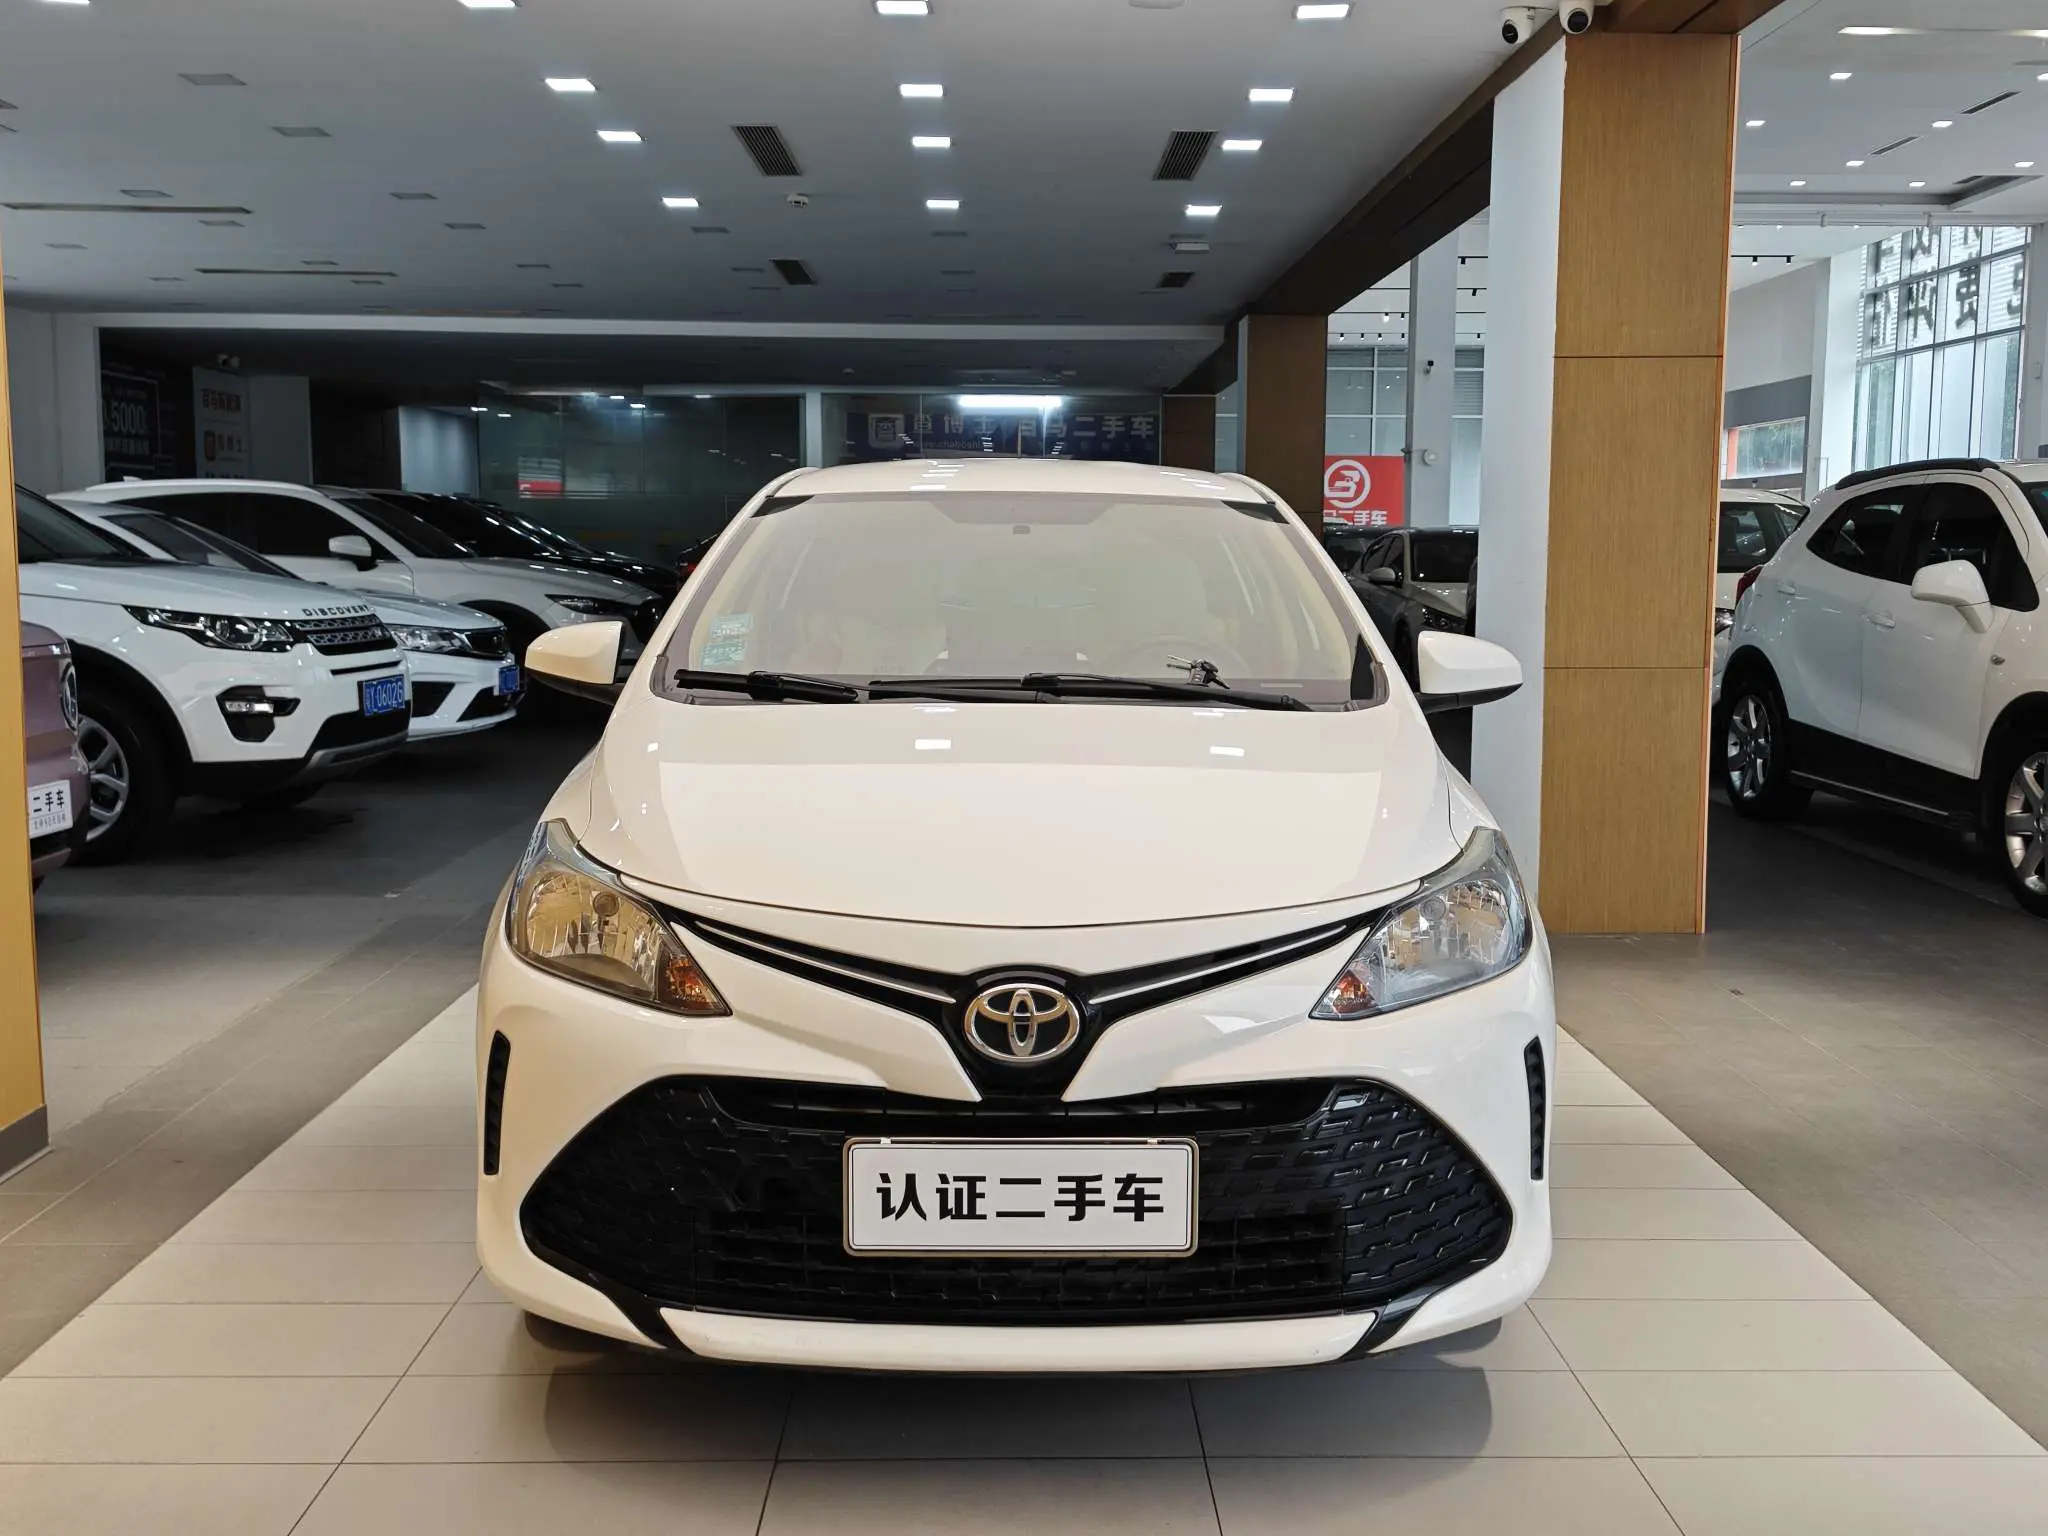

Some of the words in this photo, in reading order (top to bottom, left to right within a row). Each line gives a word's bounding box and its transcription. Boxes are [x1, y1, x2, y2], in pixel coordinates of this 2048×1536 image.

[876, 1173, 1164, 1221] 认证二手车
